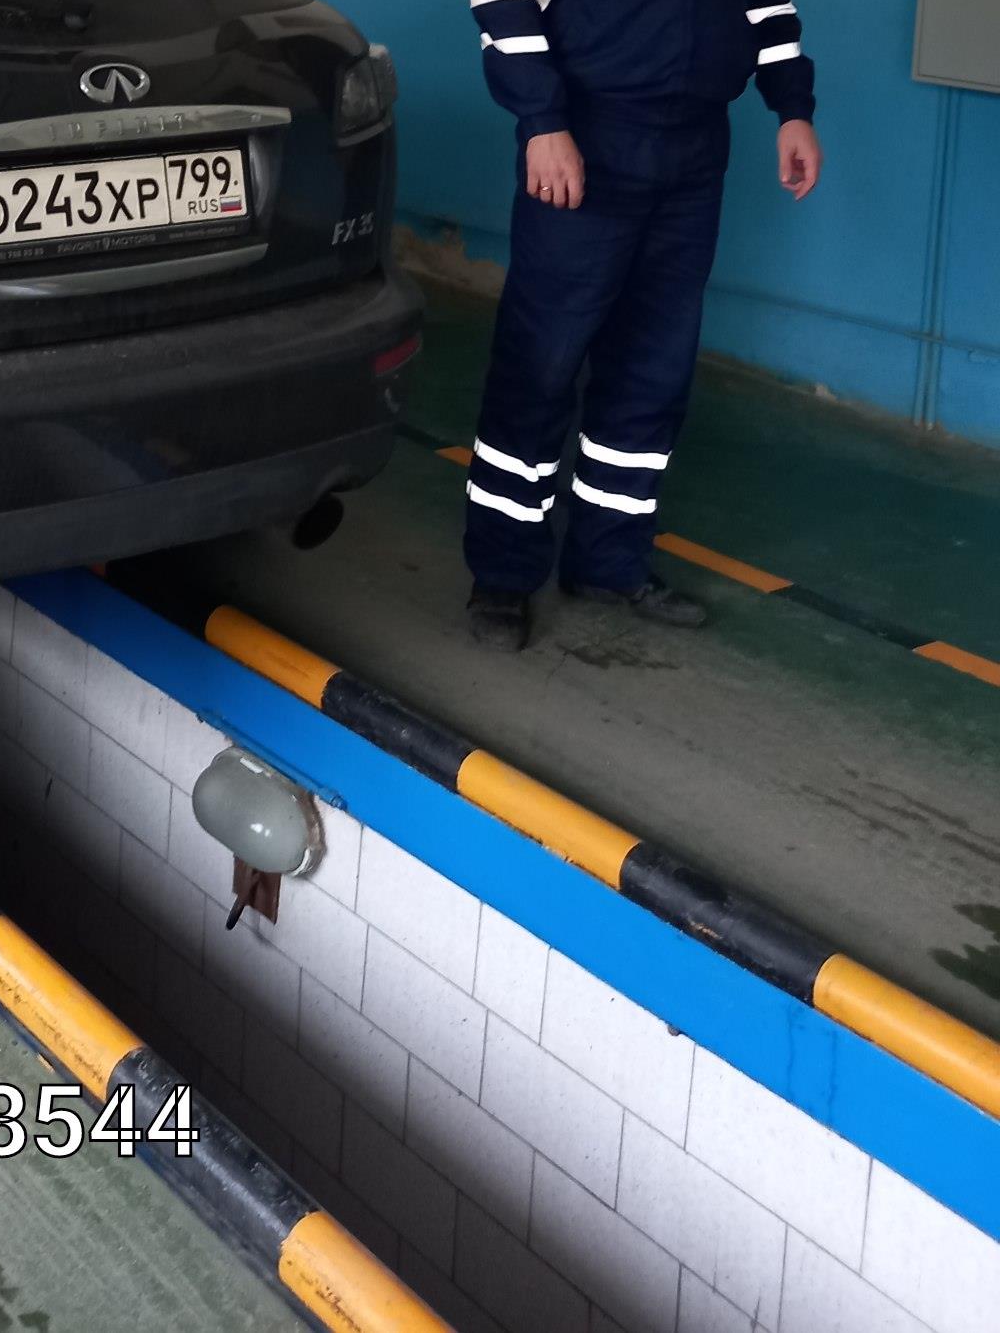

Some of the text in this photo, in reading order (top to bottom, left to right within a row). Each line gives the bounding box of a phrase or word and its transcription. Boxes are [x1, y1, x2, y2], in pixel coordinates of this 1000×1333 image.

[48, 113, 199, 142] INFINIT
[168, 156, 232, 200] 799
[187, 199, 219, 215] RUS
